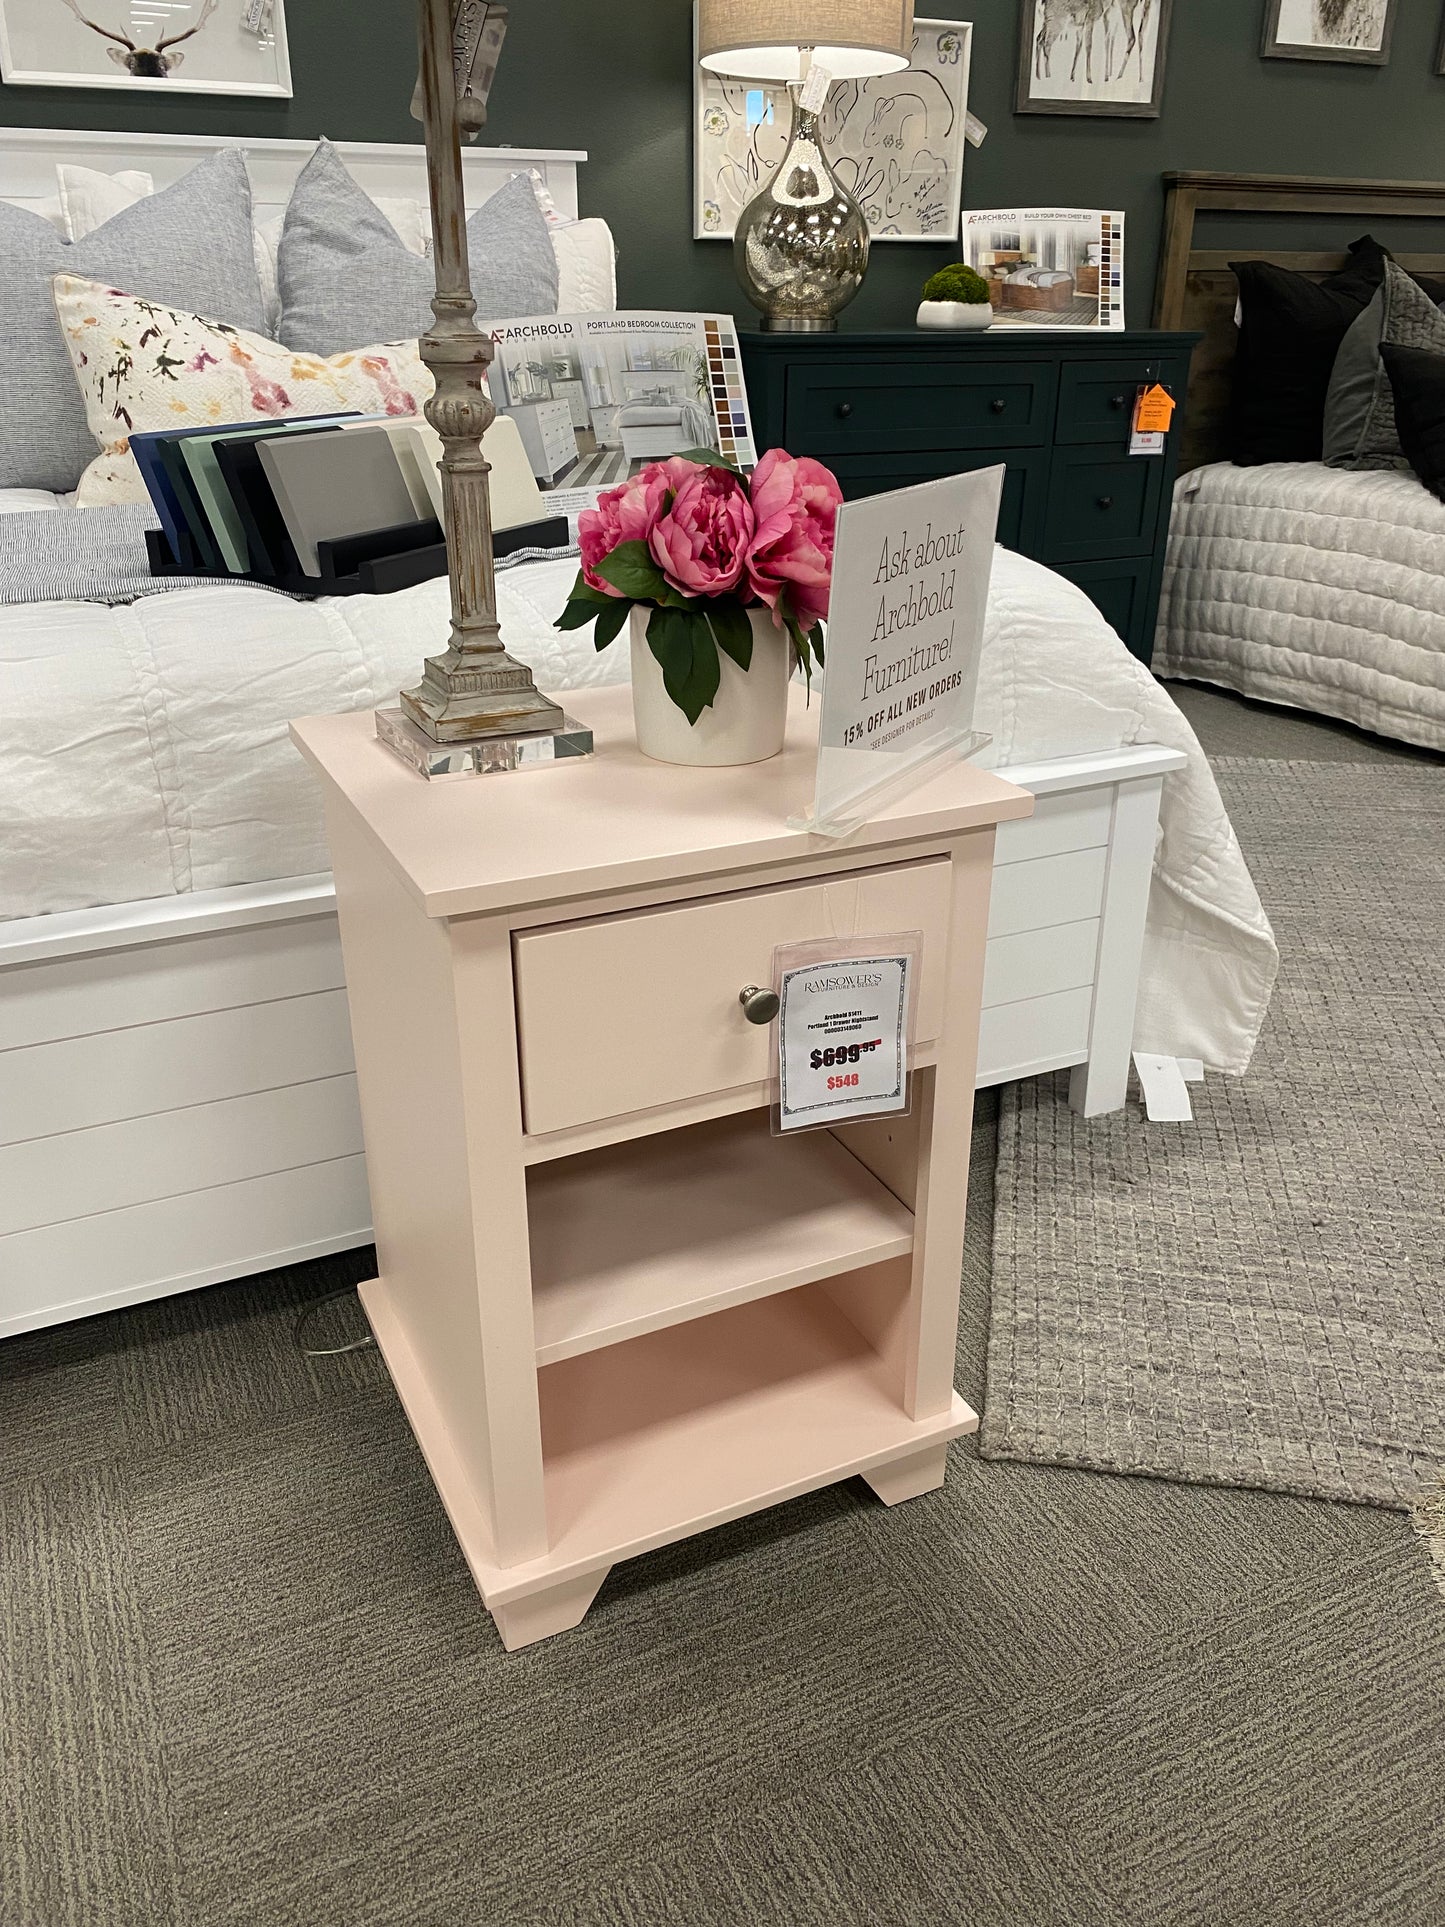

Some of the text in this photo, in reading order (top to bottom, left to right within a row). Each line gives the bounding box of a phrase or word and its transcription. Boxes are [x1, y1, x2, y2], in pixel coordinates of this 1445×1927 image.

[977, 213, 1016, 221] ARCHBOLD
[506, 323, 573, 339] ARCHBOLD
[587, 320, 696, 329] PORTLAND BEDROOM COLLECTION
[506, 333, 574, 344] FURNITURE
[873, 522, 965, 584] Ask about
[870, 569, 956, 642] Archbold
[861, 619, 955, 701] Furniture!
[843, 670, 962, 746] 15% OFF ALL NEW ORDERS
[882, 725, 905, 745] DESIGNER
[906, 719, 915, 731] FOR
[804, 974, 882, 993] RAMSOWER'S
[817, 984, 850, 993] FURNITURE
[824, 1012, 847, 1020] Archbold
[807, 1021, 829, 1030] Portland
[827, 1073, 859, 1090] $548
